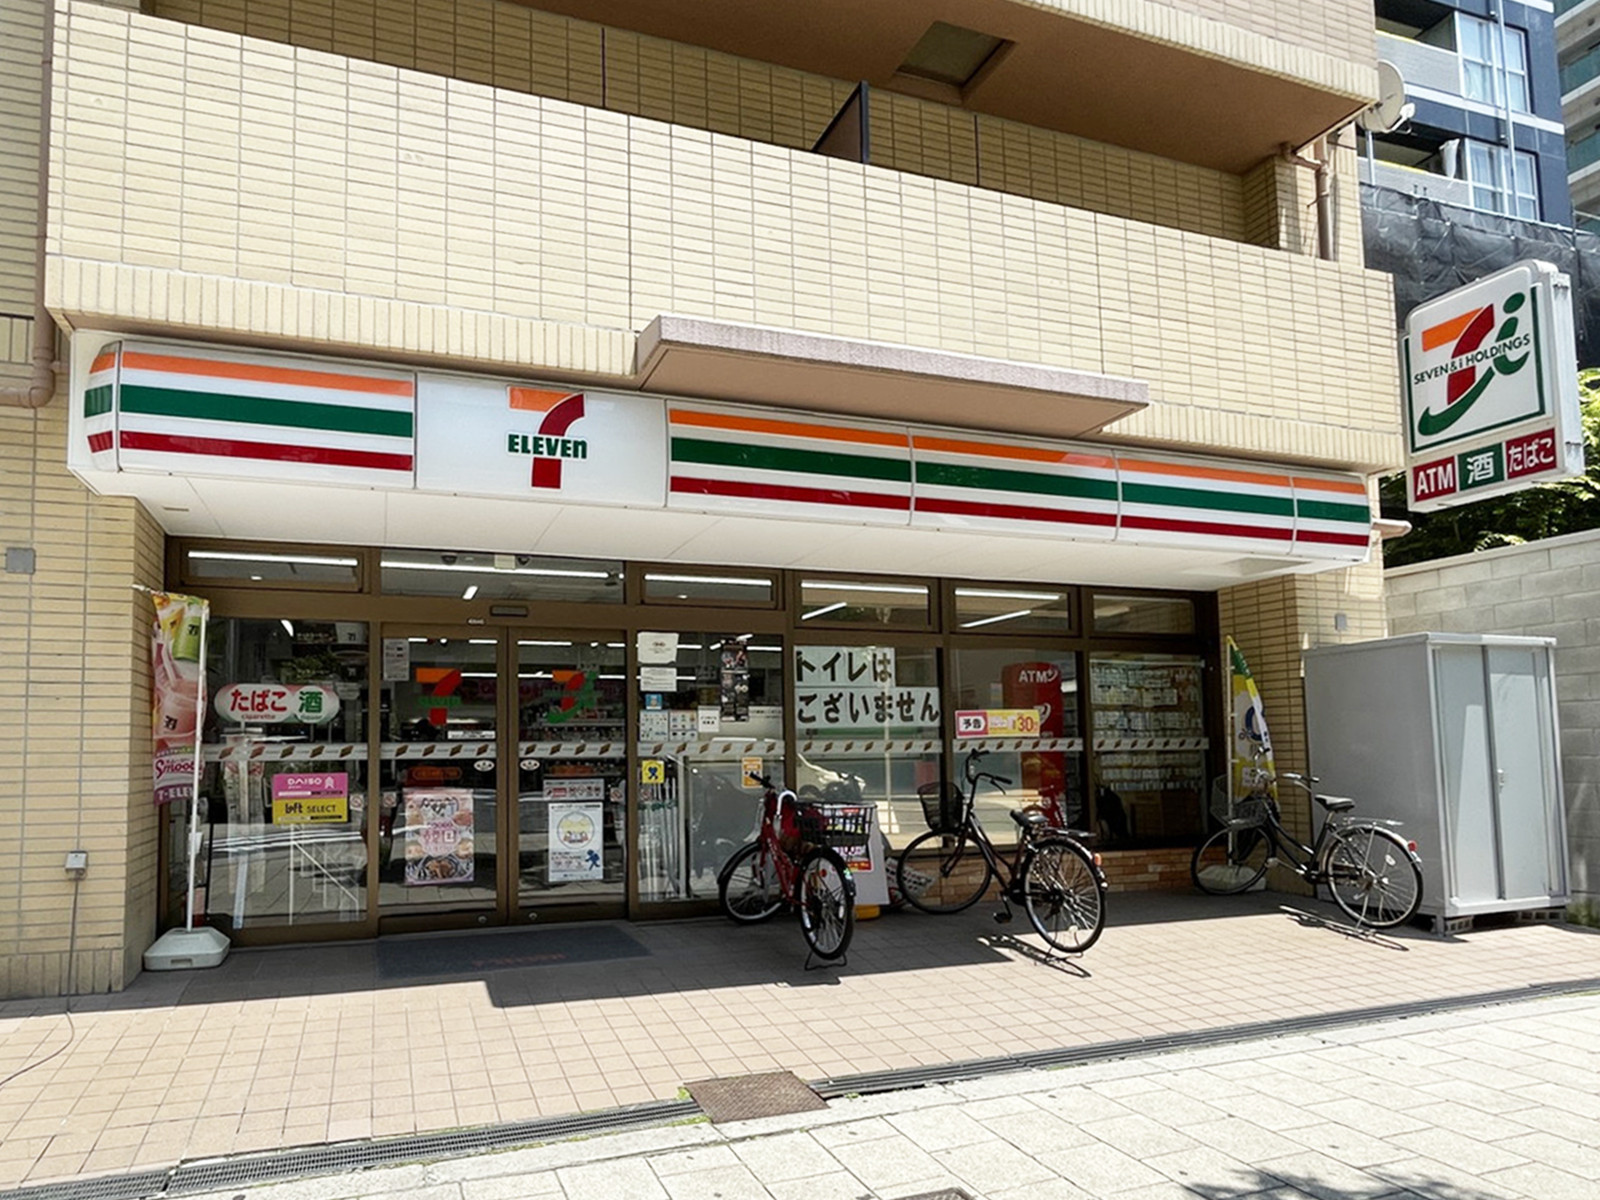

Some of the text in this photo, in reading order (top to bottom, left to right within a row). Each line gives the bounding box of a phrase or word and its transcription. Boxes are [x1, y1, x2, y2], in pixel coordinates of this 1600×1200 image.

[1465, 332, 1531, 367] HOLDINGS
[508, 386, 585, 489] 7
[1466, 451, 1495, 485] 酒
[1508, 437, 1555, 473] たばこ
[1416, 463, 1454, 497] ATM
[796, 650, 892, 683] トイレは
[1018, 669, 1047, 683] ATM
[230, 689, 287, 711] たばこ
[299, 690, 323, 713] 酒
[287, 777, 322, 786] DAISO
[306, 804, 336, 813] SELECT
